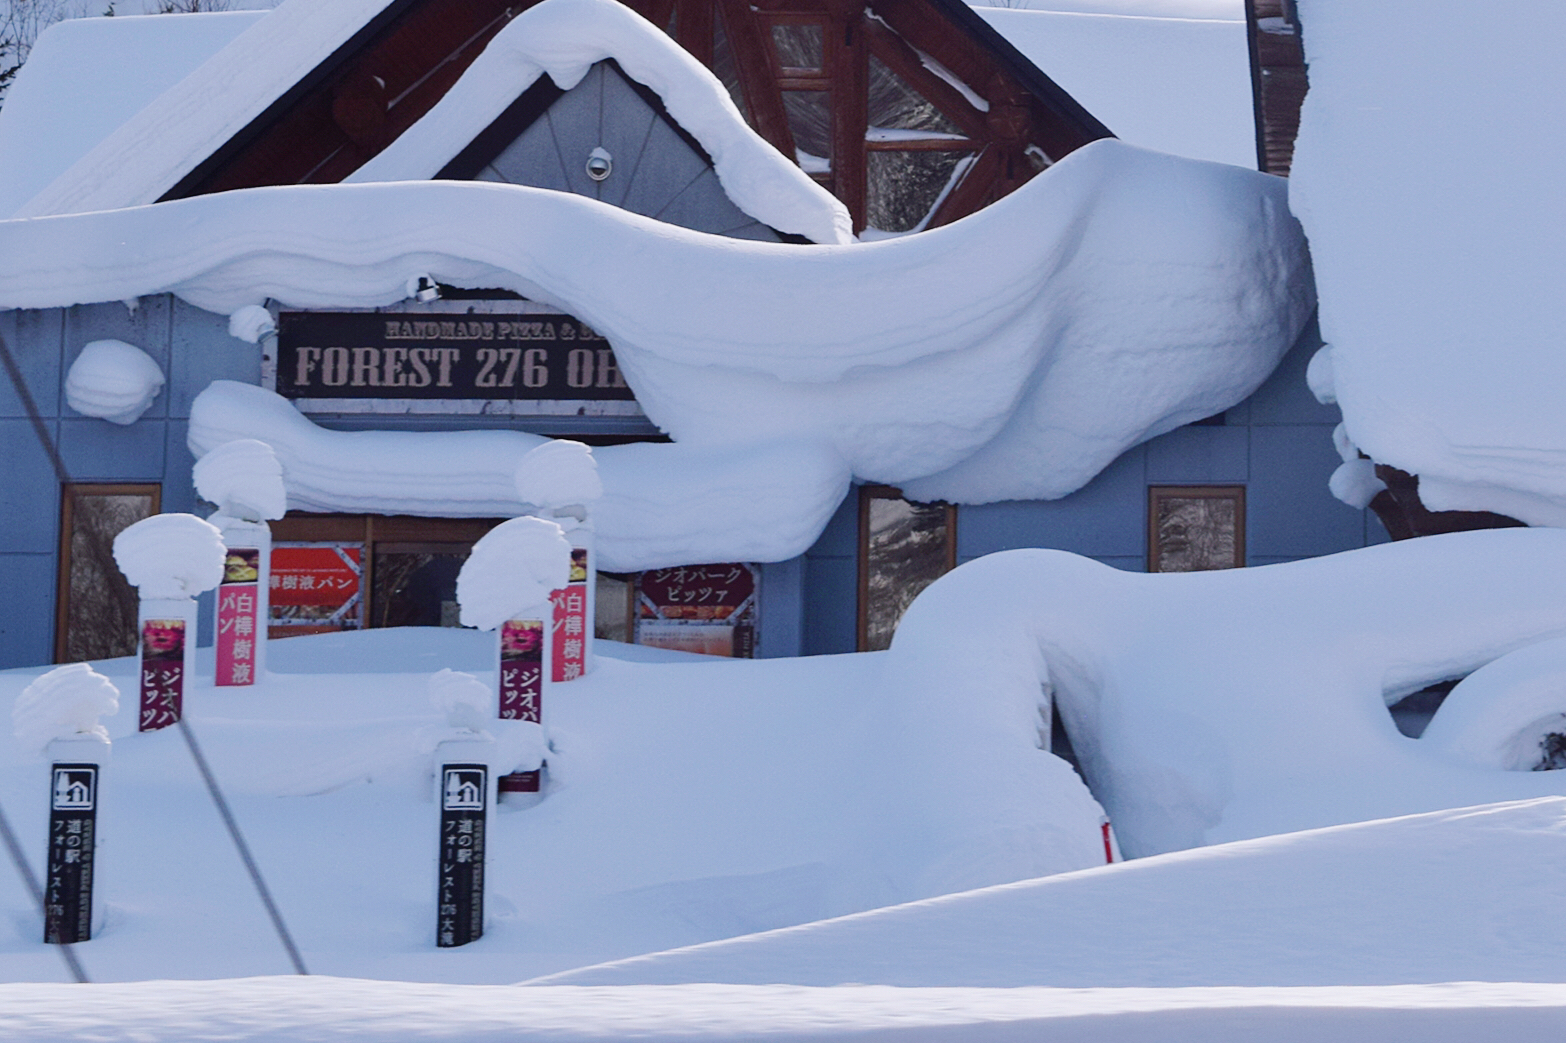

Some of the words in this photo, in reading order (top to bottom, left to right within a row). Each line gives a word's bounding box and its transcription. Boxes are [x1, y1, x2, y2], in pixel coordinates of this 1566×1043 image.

[385, 321, 494, 340] HANDMADE
[498, 322, 556, 340] PIZZA
[559, 322, 576, 340] &
[294, 347, 461, 387] FOREST
[475, 348, 548, 387] 276
[655, 567, 742, 585] ジオパーク
[220, 592, 236, 634] パン
[232, 593, 254, 683] 白樺樹液
[64, 819, 81, 863] 道の駅
[457, 819, 473, 863] 道の駅
